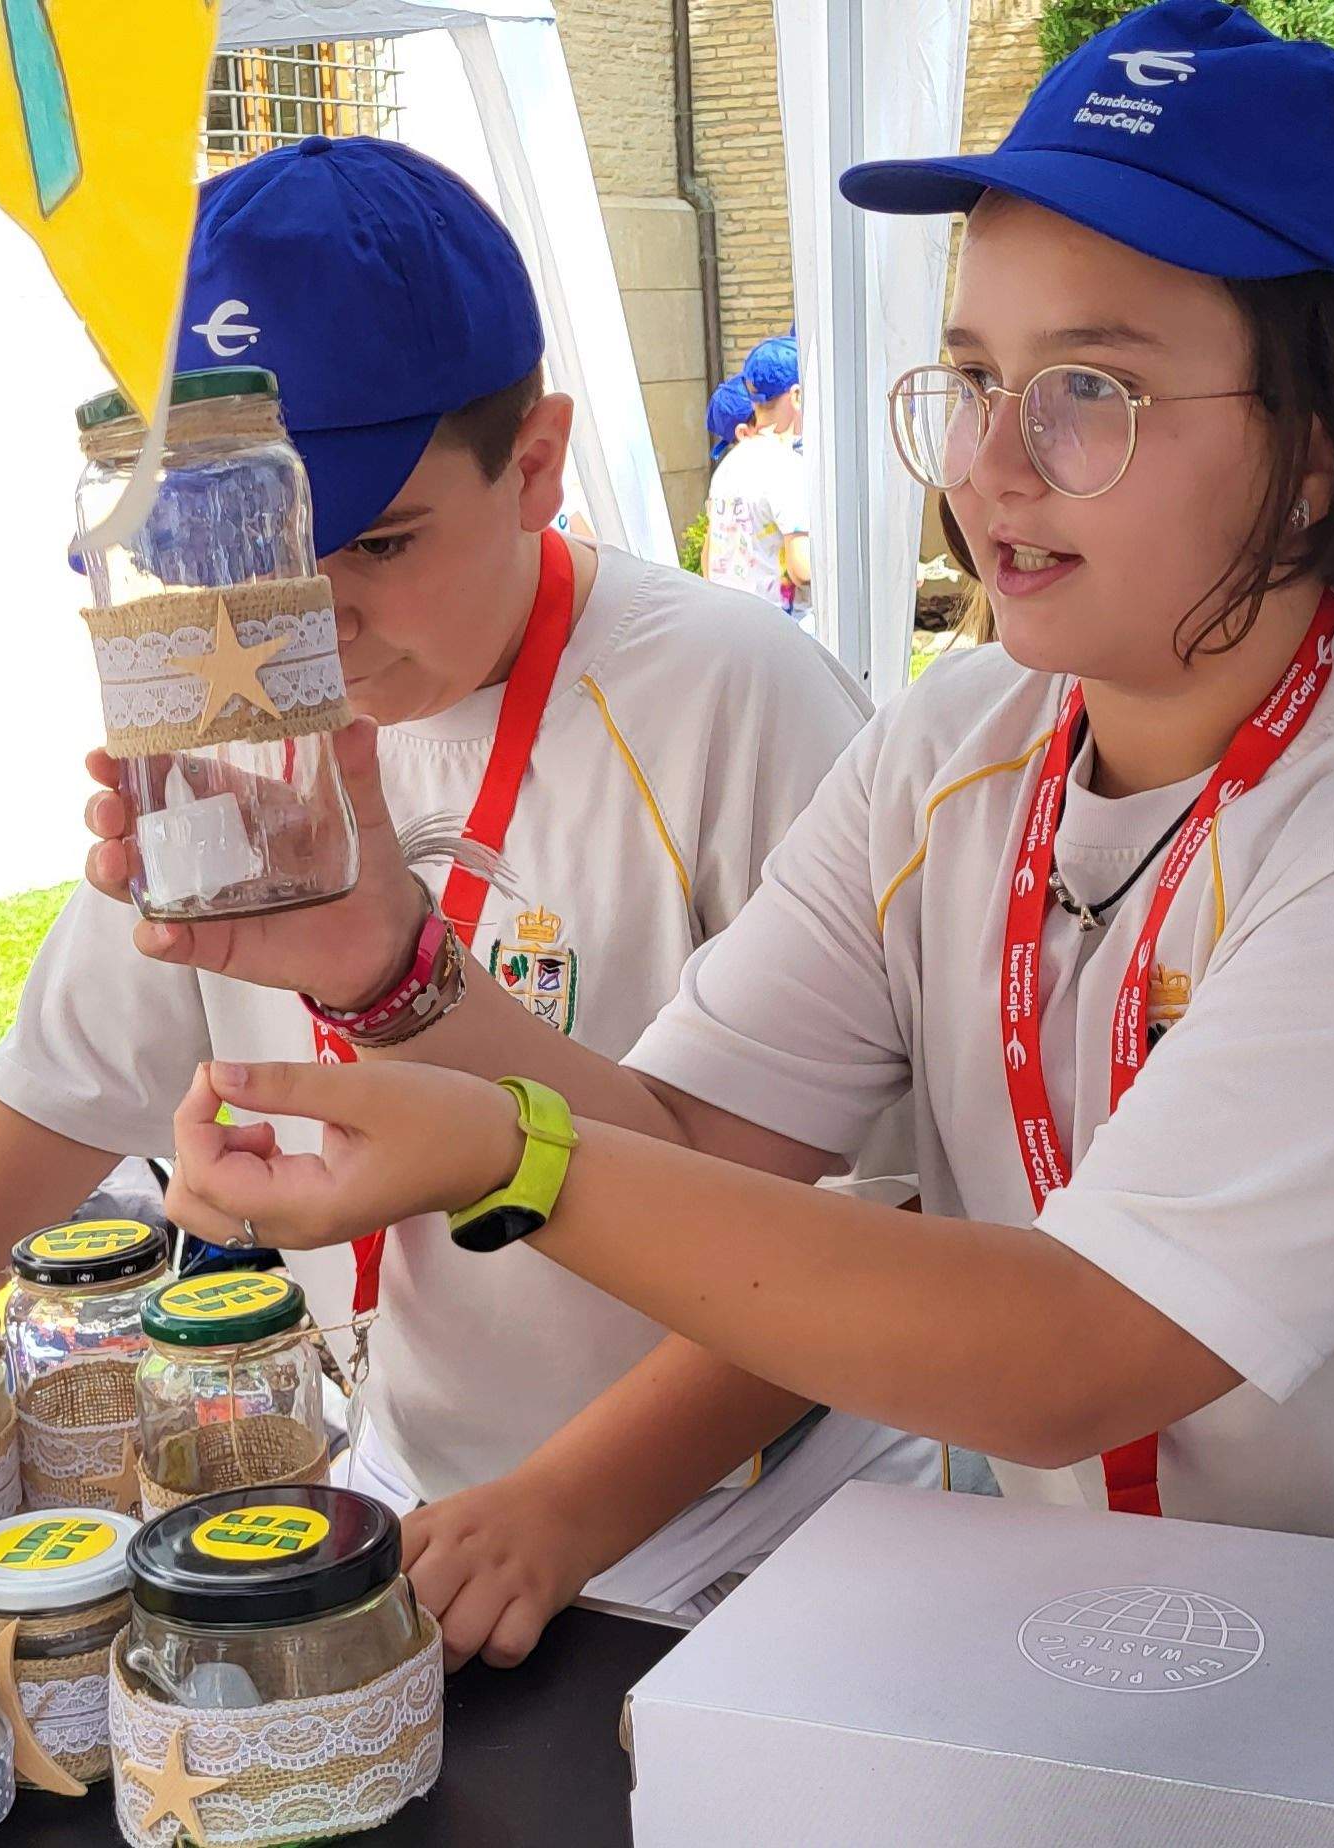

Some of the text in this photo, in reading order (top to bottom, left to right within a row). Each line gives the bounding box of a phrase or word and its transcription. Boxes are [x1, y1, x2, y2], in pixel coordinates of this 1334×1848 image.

[1086, 92, 1163, 116] Fundación
[1252, 661, 1303, 729] Fundación
[1040, 775, 1061, 845] Fundación
[1022, 942, 1036, 1017] Fundación
[1114, 986, 1130, 1065] Fundación
[1039, 1635, 1225, 1684] END PLASTIC
[1078, 1635, 1183, 1662] WASTE
